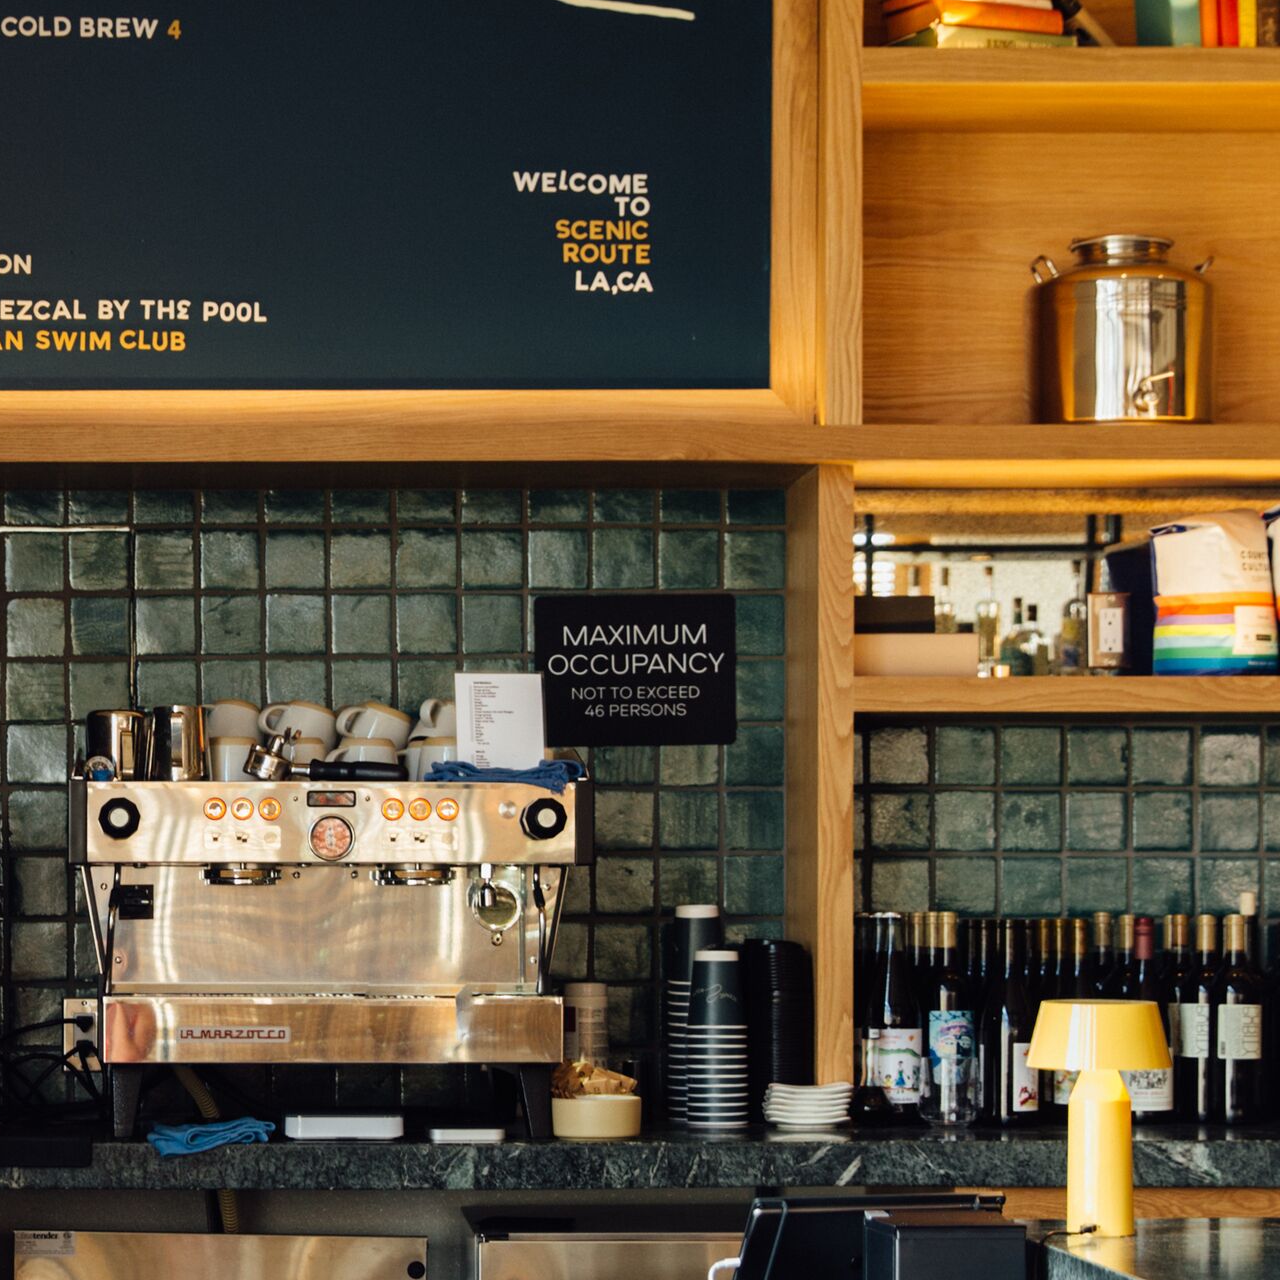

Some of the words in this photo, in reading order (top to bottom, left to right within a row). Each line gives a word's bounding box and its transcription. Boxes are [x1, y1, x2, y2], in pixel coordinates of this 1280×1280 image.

[1, 16, 71, 37] COLD
[80, 17, 158, 39] BREW
[168, 20, 181, 39] 4
[614, 197, 650, 216] TO
[556, 220, 648, 240] SCENIC
[563, 243, 650, 264] ROUTE
[98, 300, 129, 320] BY
[140, 300, 191, 320] THE
[203, 302, 267, 322] POOL
[36, 330, 111, 351] SWIM
[120, 330, 185, 351] CLUB
[563, 624, 706, 646] MAXIMUM
[548, 653, 724, 675] OCCUPANCY
[572, 687, 605, 700] NOT
[610, 686, 632, 699] TO
[637, 686, 700, 699] EXCEED
[585, 704, 604, 717] 46
[610, 703, 687, 716] PERSONS
